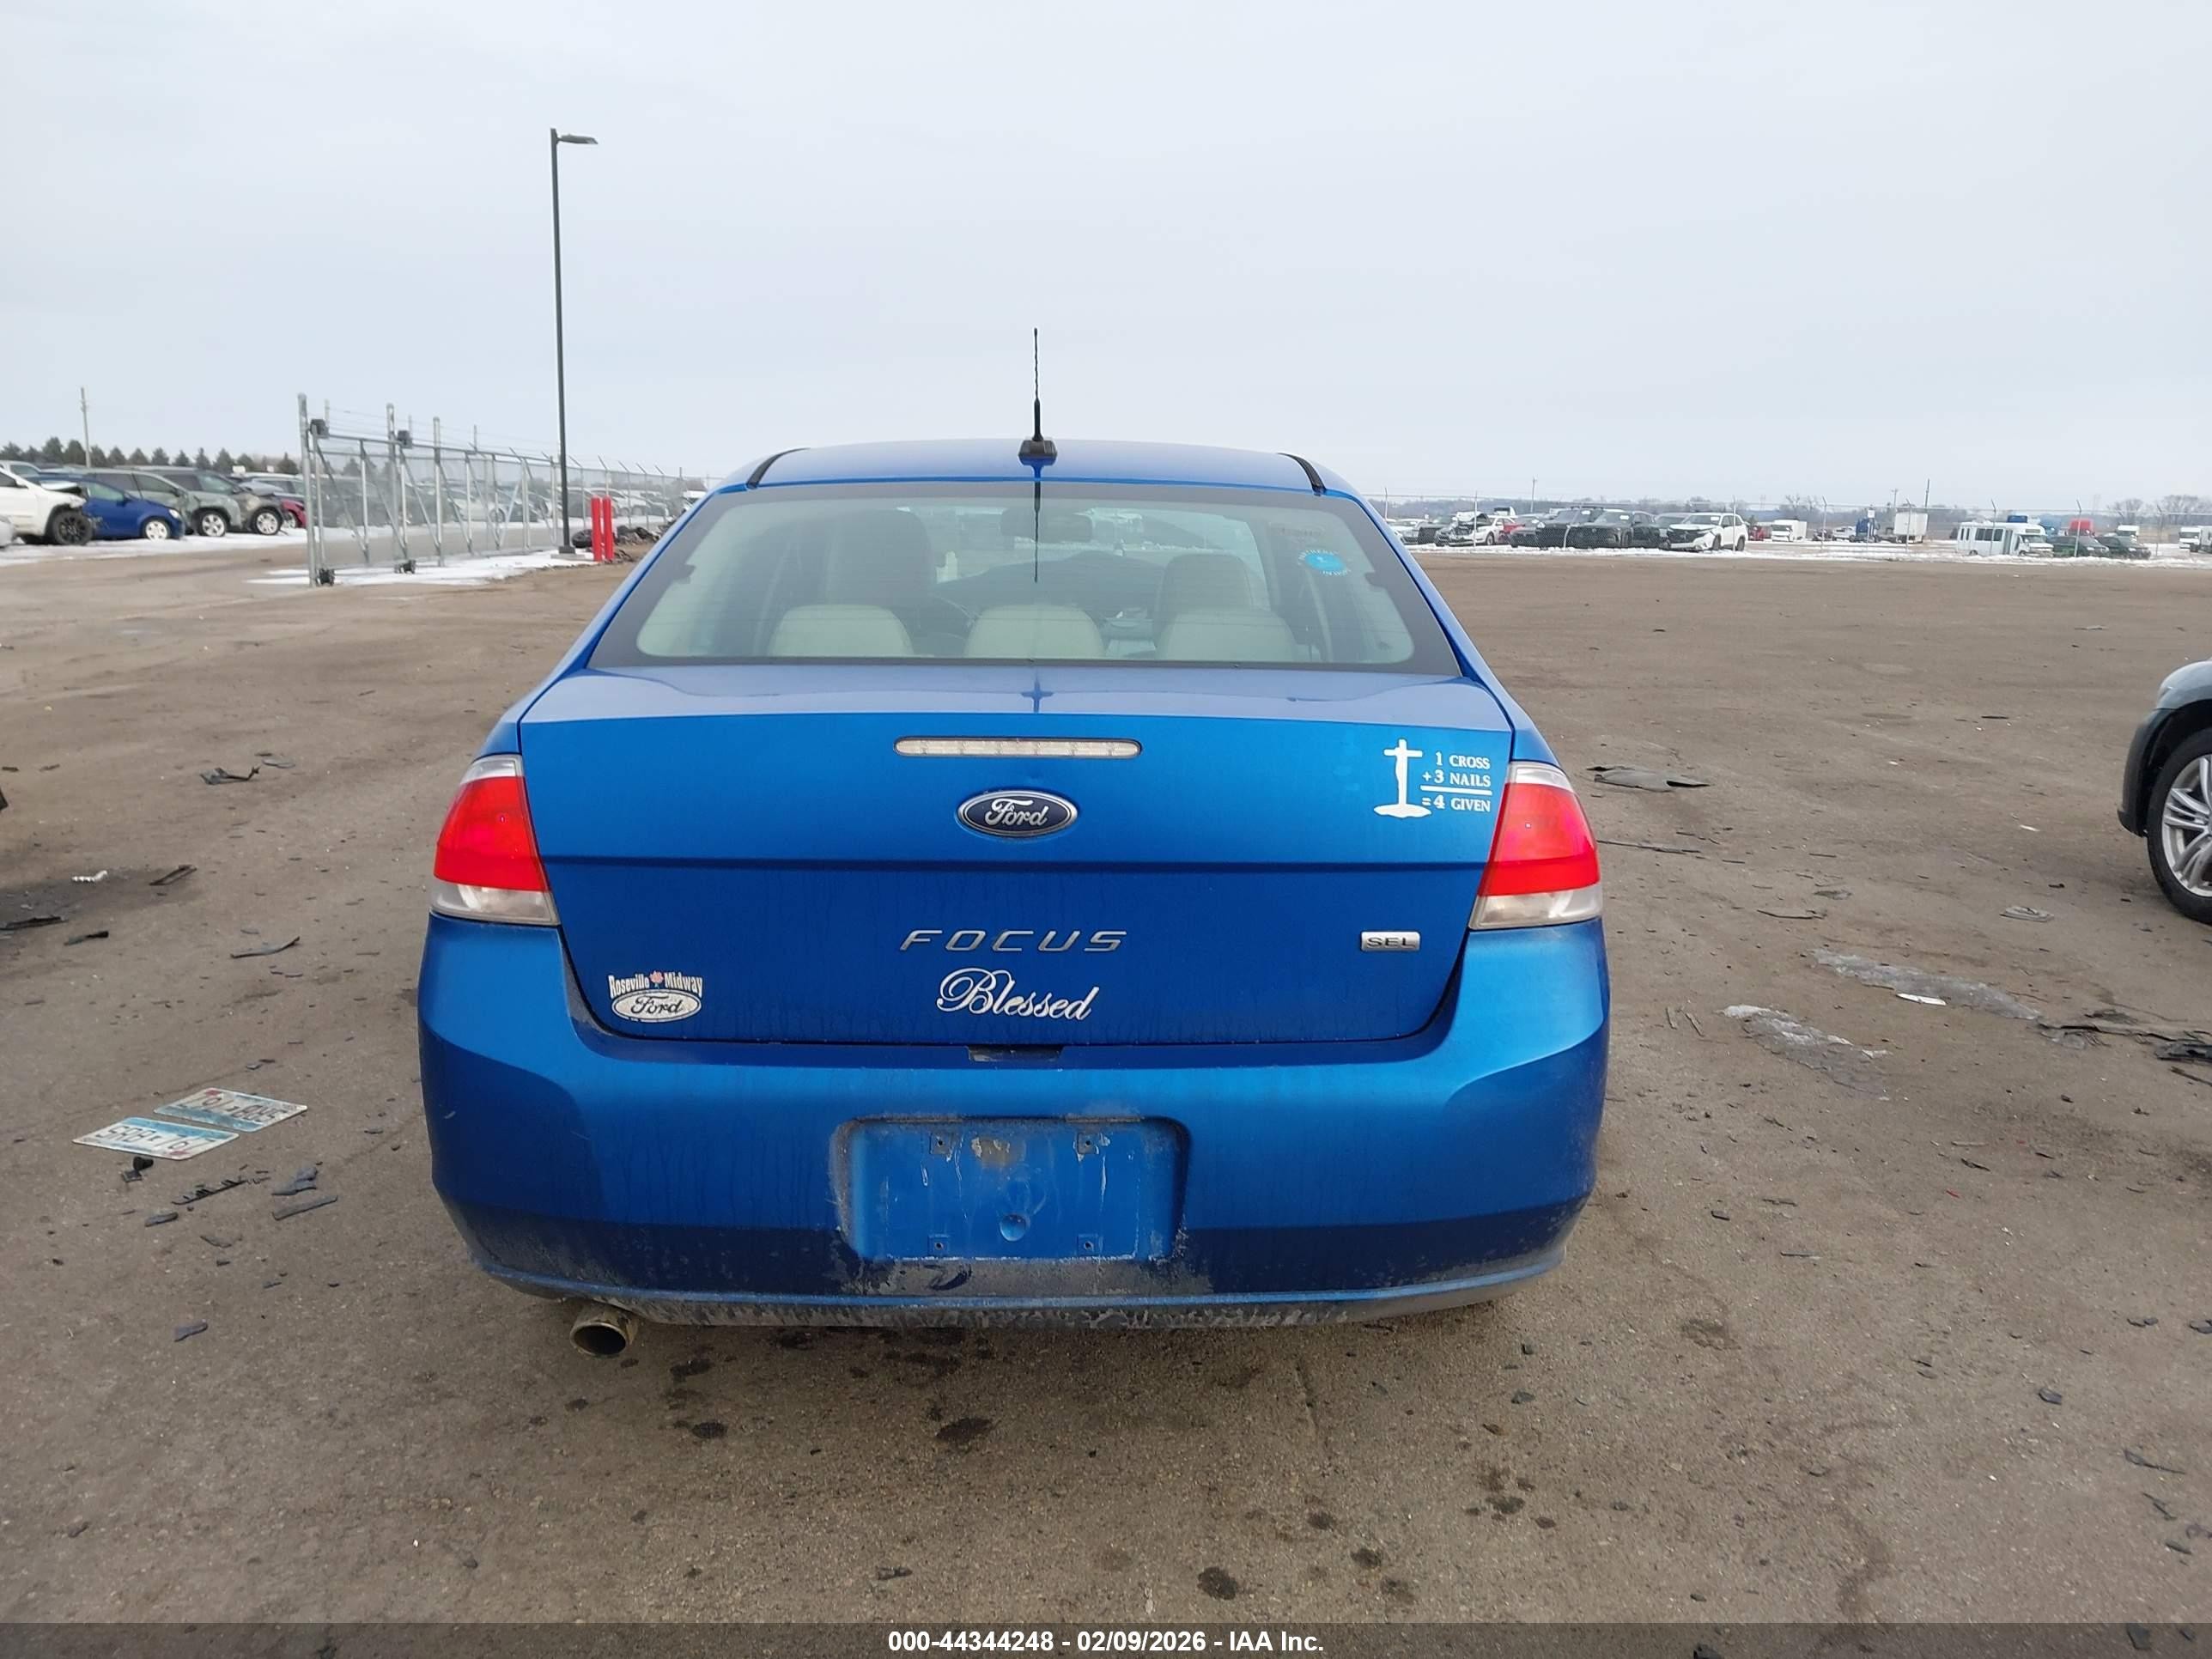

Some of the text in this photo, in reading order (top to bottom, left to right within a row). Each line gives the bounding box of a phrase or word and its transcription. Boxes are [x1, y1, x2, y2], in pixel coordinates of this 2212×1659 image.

[1435, 751, 1492, 770] 1 CROSS
[1449, 772, 1492, 788] NAILS
[985, 798, 1049, 826] Ford
[1450, 797, 1492, 812] GIVEN
[899, 929, 1127, 952] FOCUS
[1366, 936, 1416, 949] SEL
[608, 971, 703, 1000] Roseville Midway
[936, 967, 1100, 1021] Blessed
[630, 994, 684, 1015] Ford
